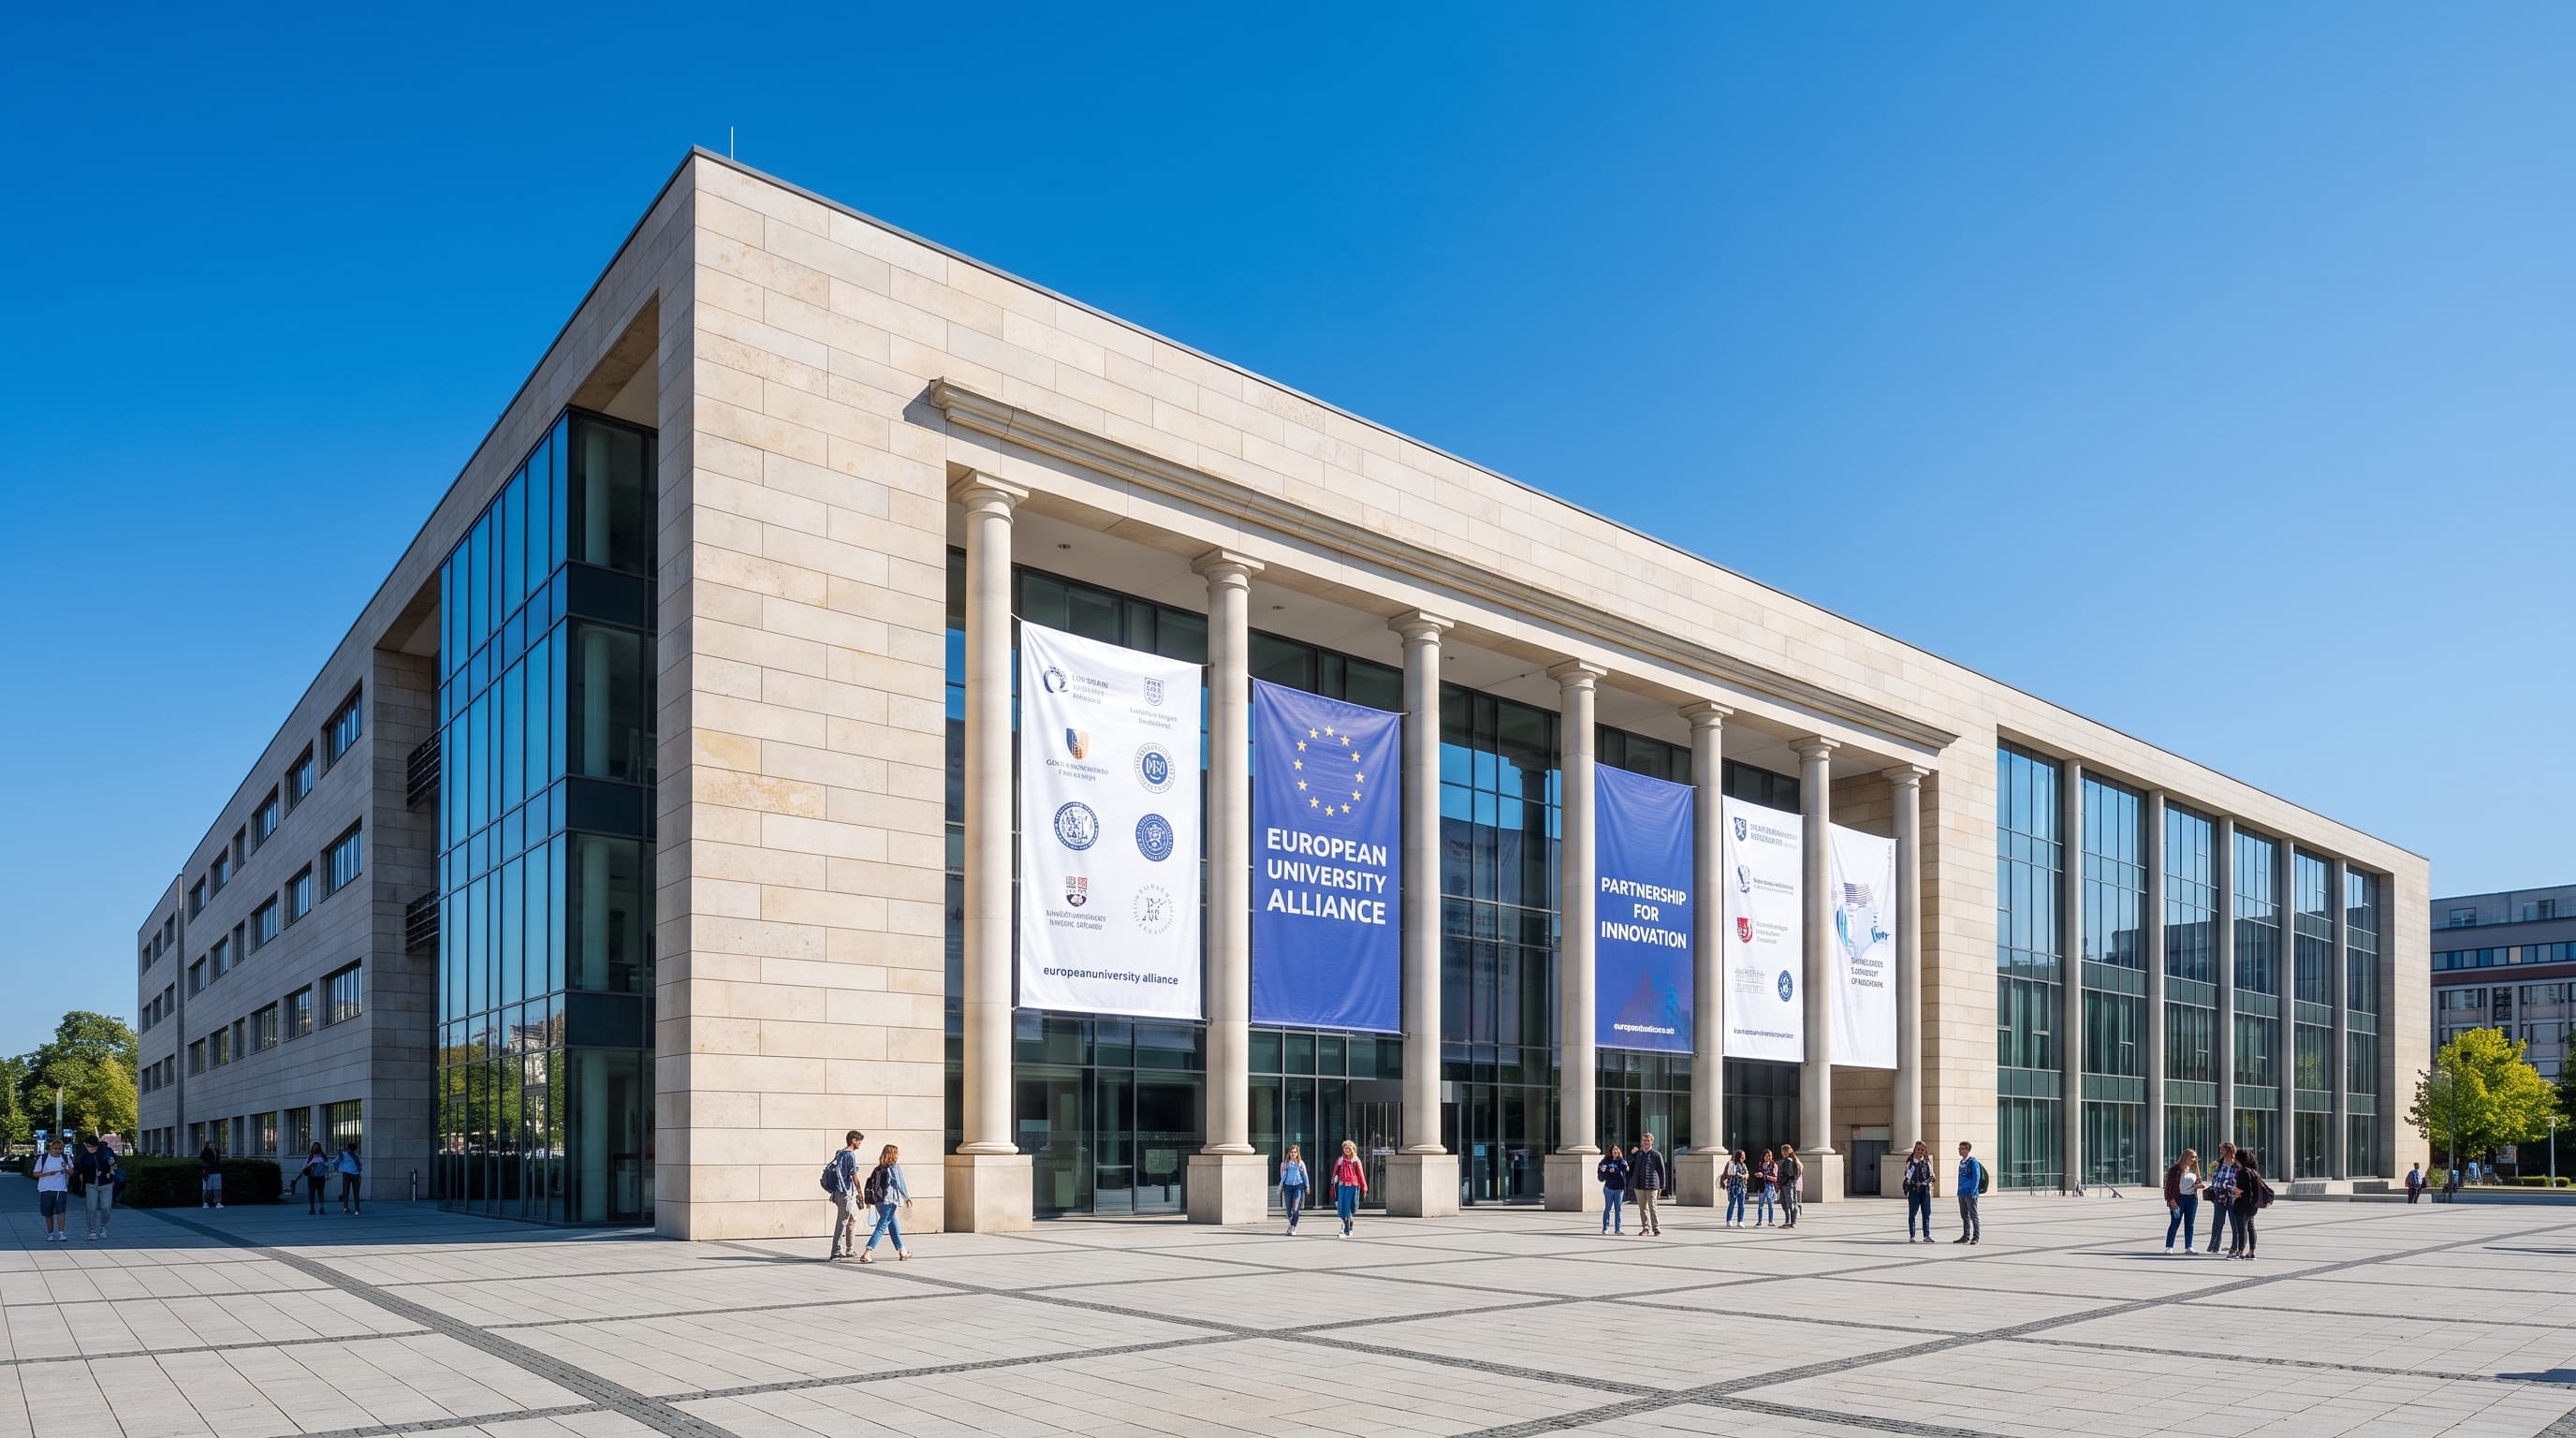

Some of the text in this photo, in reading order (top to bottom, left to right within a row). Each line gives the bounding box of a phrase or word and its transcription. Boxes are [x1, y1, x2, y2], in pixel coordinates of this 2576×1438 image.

[1267, 827, 1386, 867] EUROPEAN
[1267, 858, 1386, 894] UNIVERSITY
[1601, 876, 1687, 906] PARTNERSHIP
[1266, 888, 1386, 925] ALLIANCE
[1633, 902, 1660, 922] FOR
[1601, 920, 1687, 949] INNOVATION
[1043, 966, 1178, 985] europeanuniversity alliance
